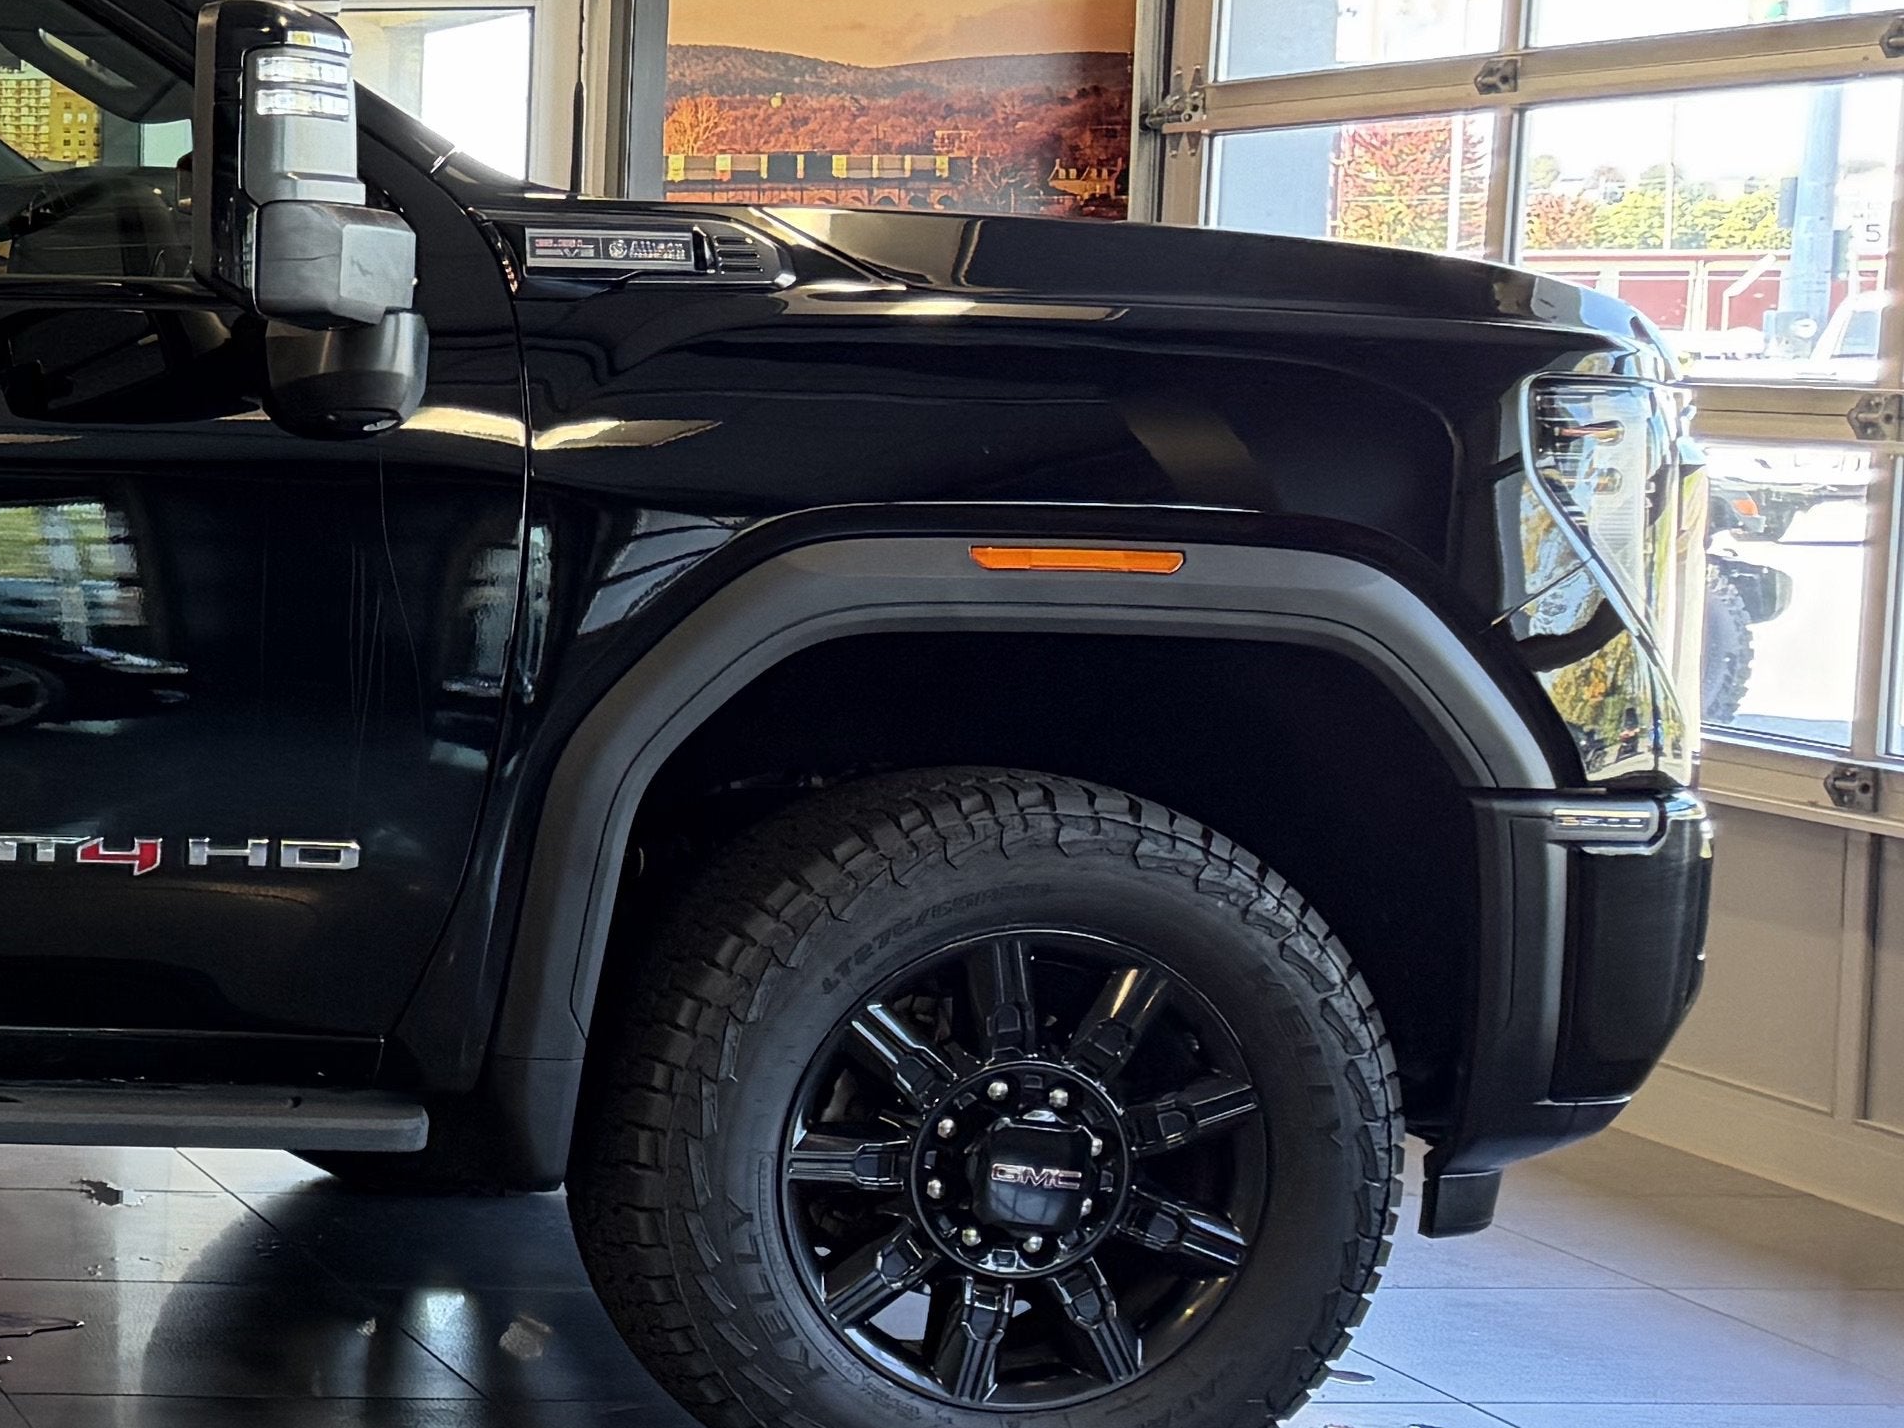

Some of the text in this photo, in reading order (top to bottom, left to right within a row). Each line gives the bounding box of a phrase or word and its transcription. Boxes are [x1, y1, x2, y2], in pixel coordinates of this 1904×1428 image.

[187, 835, 361, 871] HD
[990, 1162, 1083, 1190] GMC
[727, 1192, 829, 1378] KELLY
